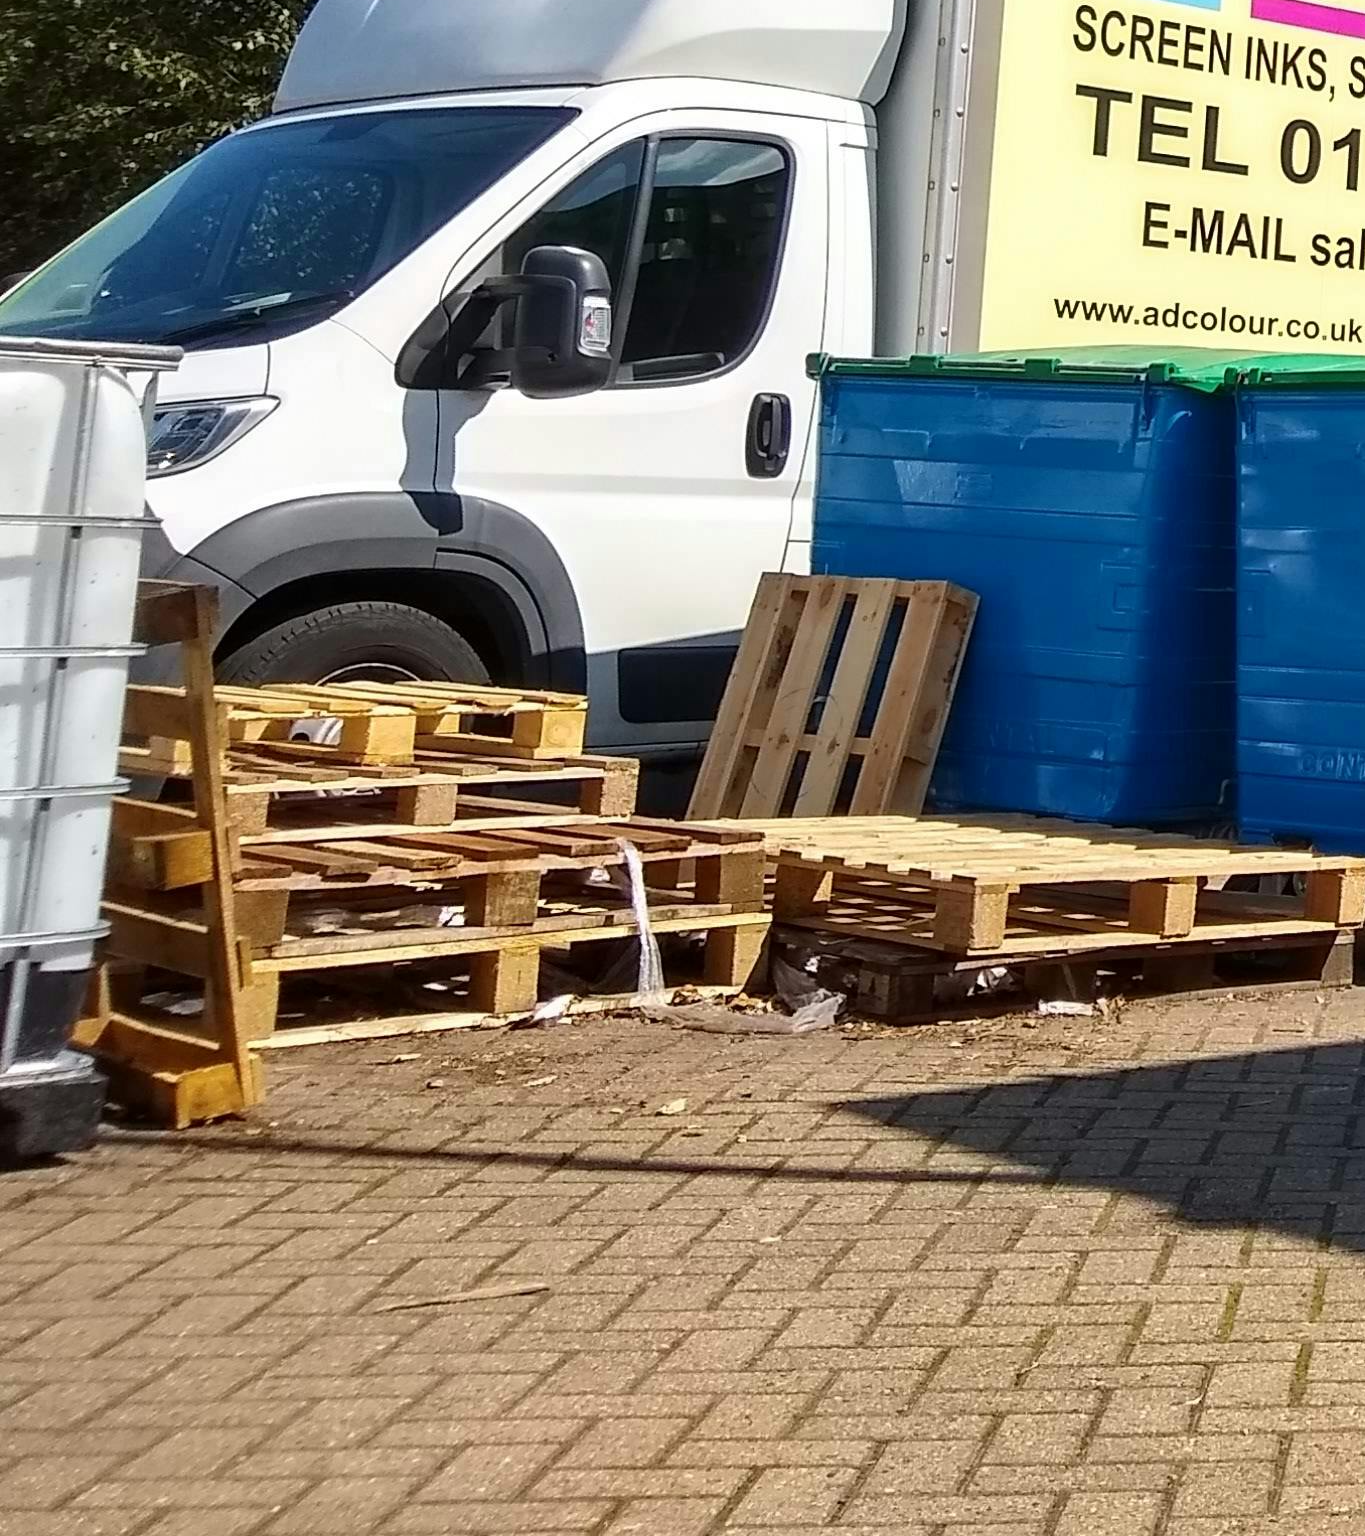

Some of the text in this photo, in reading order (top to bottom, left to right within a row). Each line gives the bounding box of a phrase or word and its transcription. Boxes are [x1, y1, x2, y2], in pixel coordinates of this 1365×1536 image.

[1072, 4, 1233, 77] SCREEN
[1244, 35, 1336, 103] INKS,
[1074, 82, 1250, 177] TEL
[1142, 200, 1297, 263] E-MAIL
[1053, 297, 1363, 343] www.adcolour.co.uk
